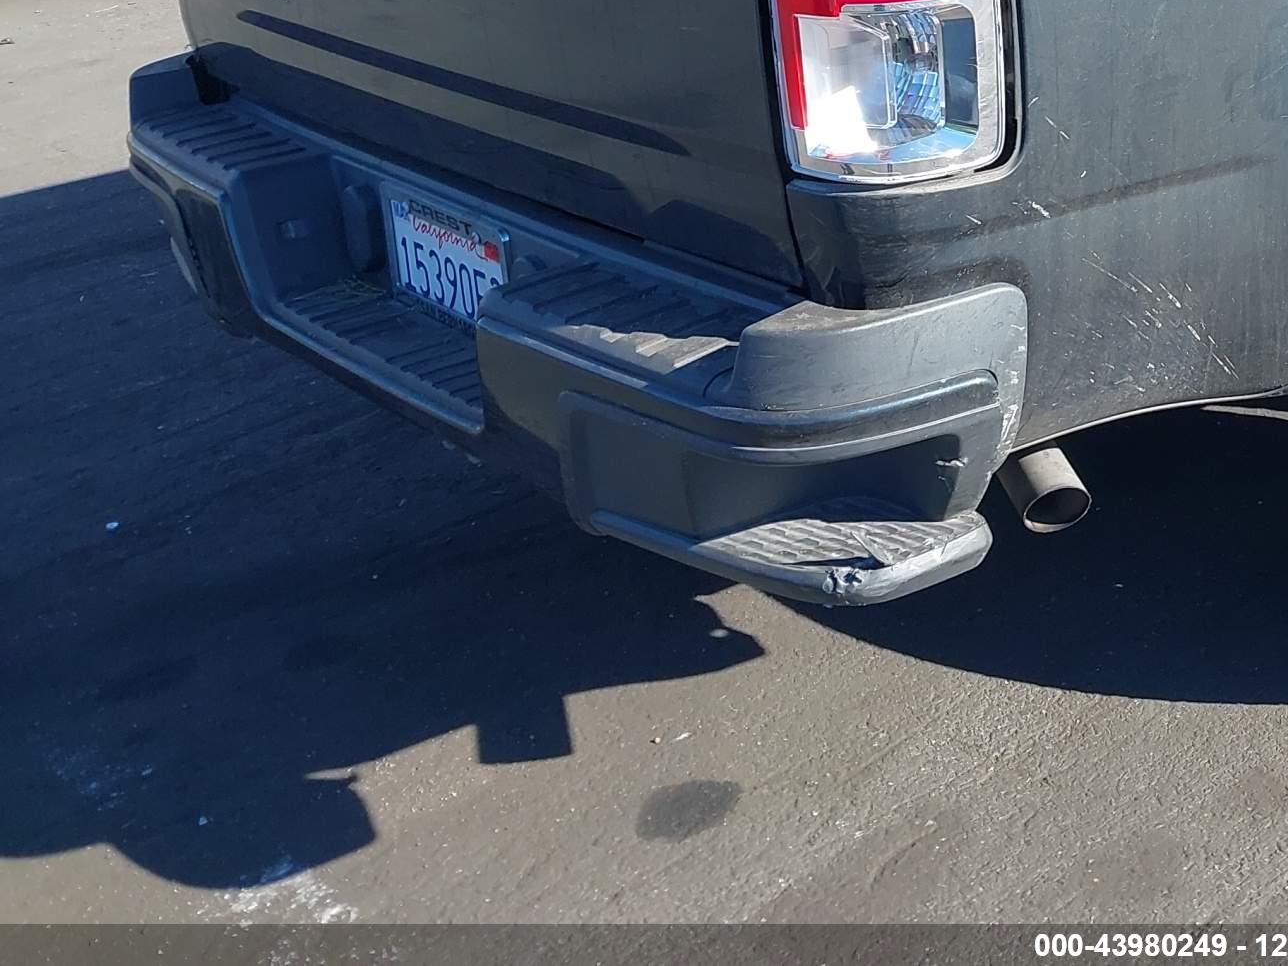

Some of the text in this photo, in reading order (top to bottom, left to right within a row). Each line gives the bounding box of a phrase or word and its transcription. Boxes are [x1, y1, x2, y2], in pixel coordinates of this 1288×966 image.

[409, 199, 473, 237] CREST
[412, 215, 479, 250] California
[400, 236, 500, 320] 15390F
